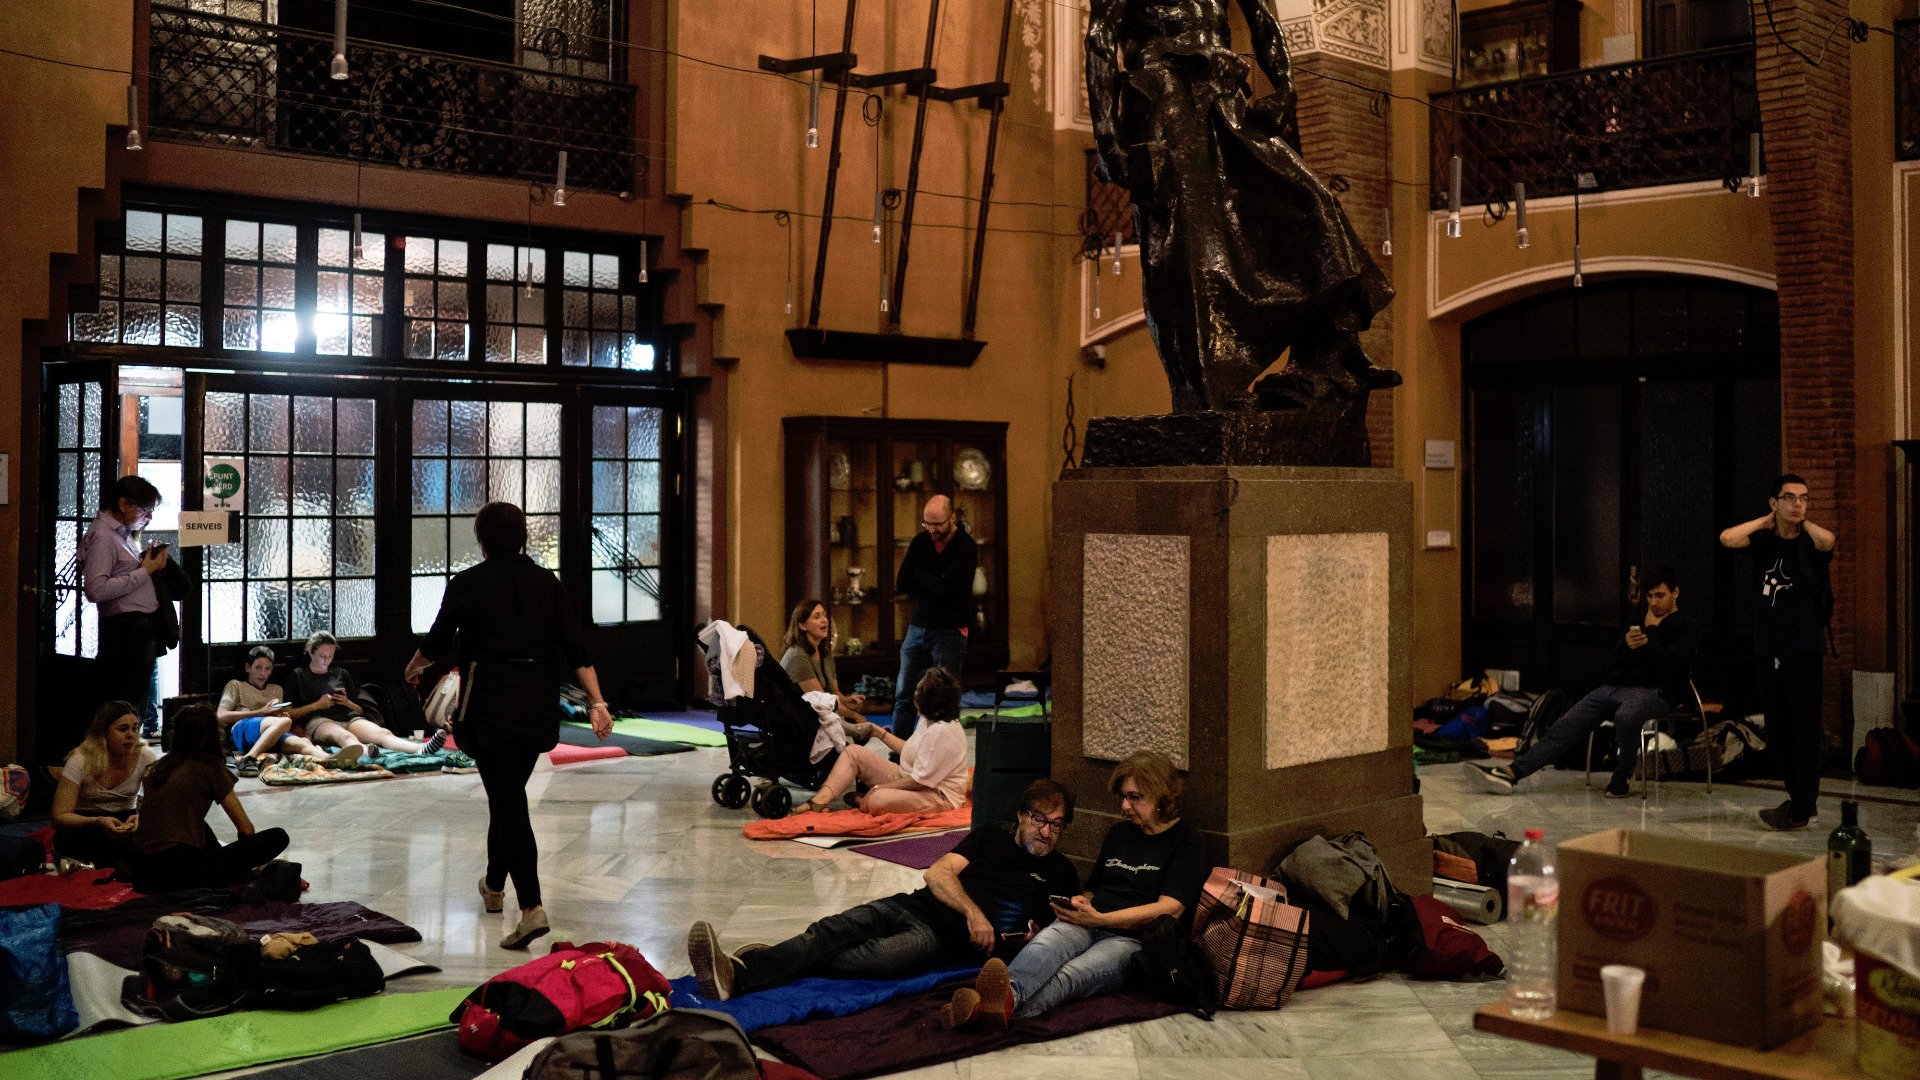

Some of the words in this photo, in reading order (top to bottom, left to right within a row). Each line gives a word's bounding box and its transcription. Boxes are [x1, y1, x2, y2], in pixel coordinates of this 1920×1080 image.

[213, 472, 233, 480] PUNT
[185, 522, 222, 530] SERVEIS
[1105, 858, 1160, 874] Champion
[1588, 889, 1646, 917] FRIT
